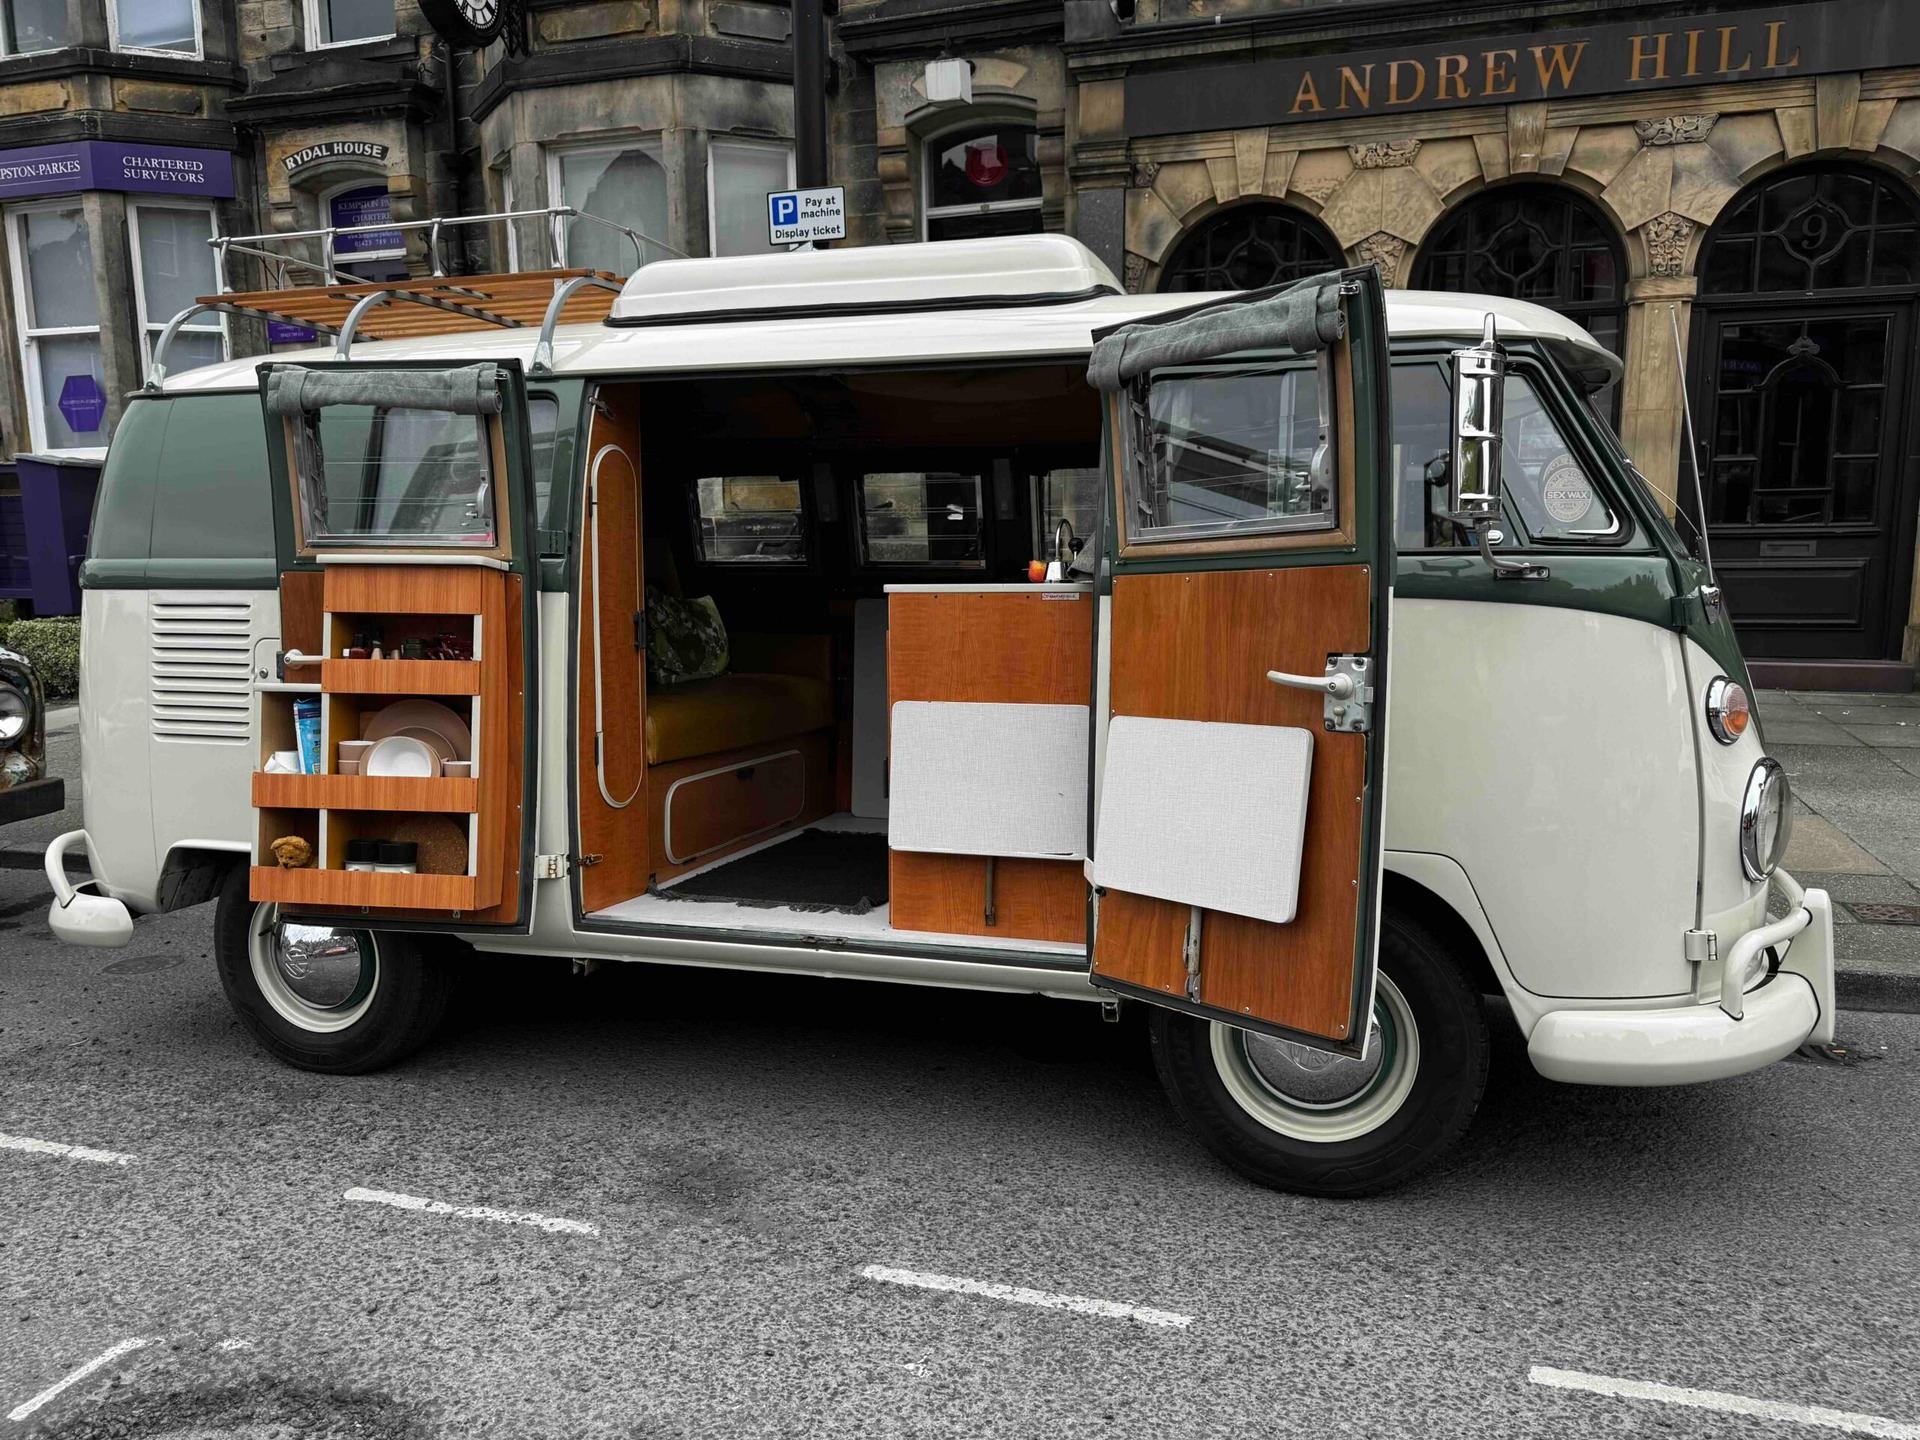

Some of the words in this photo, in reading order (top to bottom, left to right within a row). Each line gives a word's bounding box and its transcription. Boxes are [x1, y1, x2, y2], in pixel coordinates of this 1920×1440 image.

[1287, 39, 1590, 114] ANDREW
[1627, 21, 1800, 82] HILL
[122, 156, 203, 172] CHARTERED
[285, 144, 331, 170] RYDAL
[333, 142, 382, 158] HOUSE
[0, 160, 81, 180] PSTON-PARKES
[123, 168, 205, 184] SURVEYORS
[805, 197, 823, 208] Pay
[825, 195, 836, 205] at
[778, 199, 794, 223] P
[800, 207, 841, 219] machine
[775, 228, 810, 239] Display
[813, 225, 841, 235] ticket
[1801, 214, 1828, 250] 9
[1546, 491, 1566, 499] SEX
[1567, 491, 1588, 499] WAX
